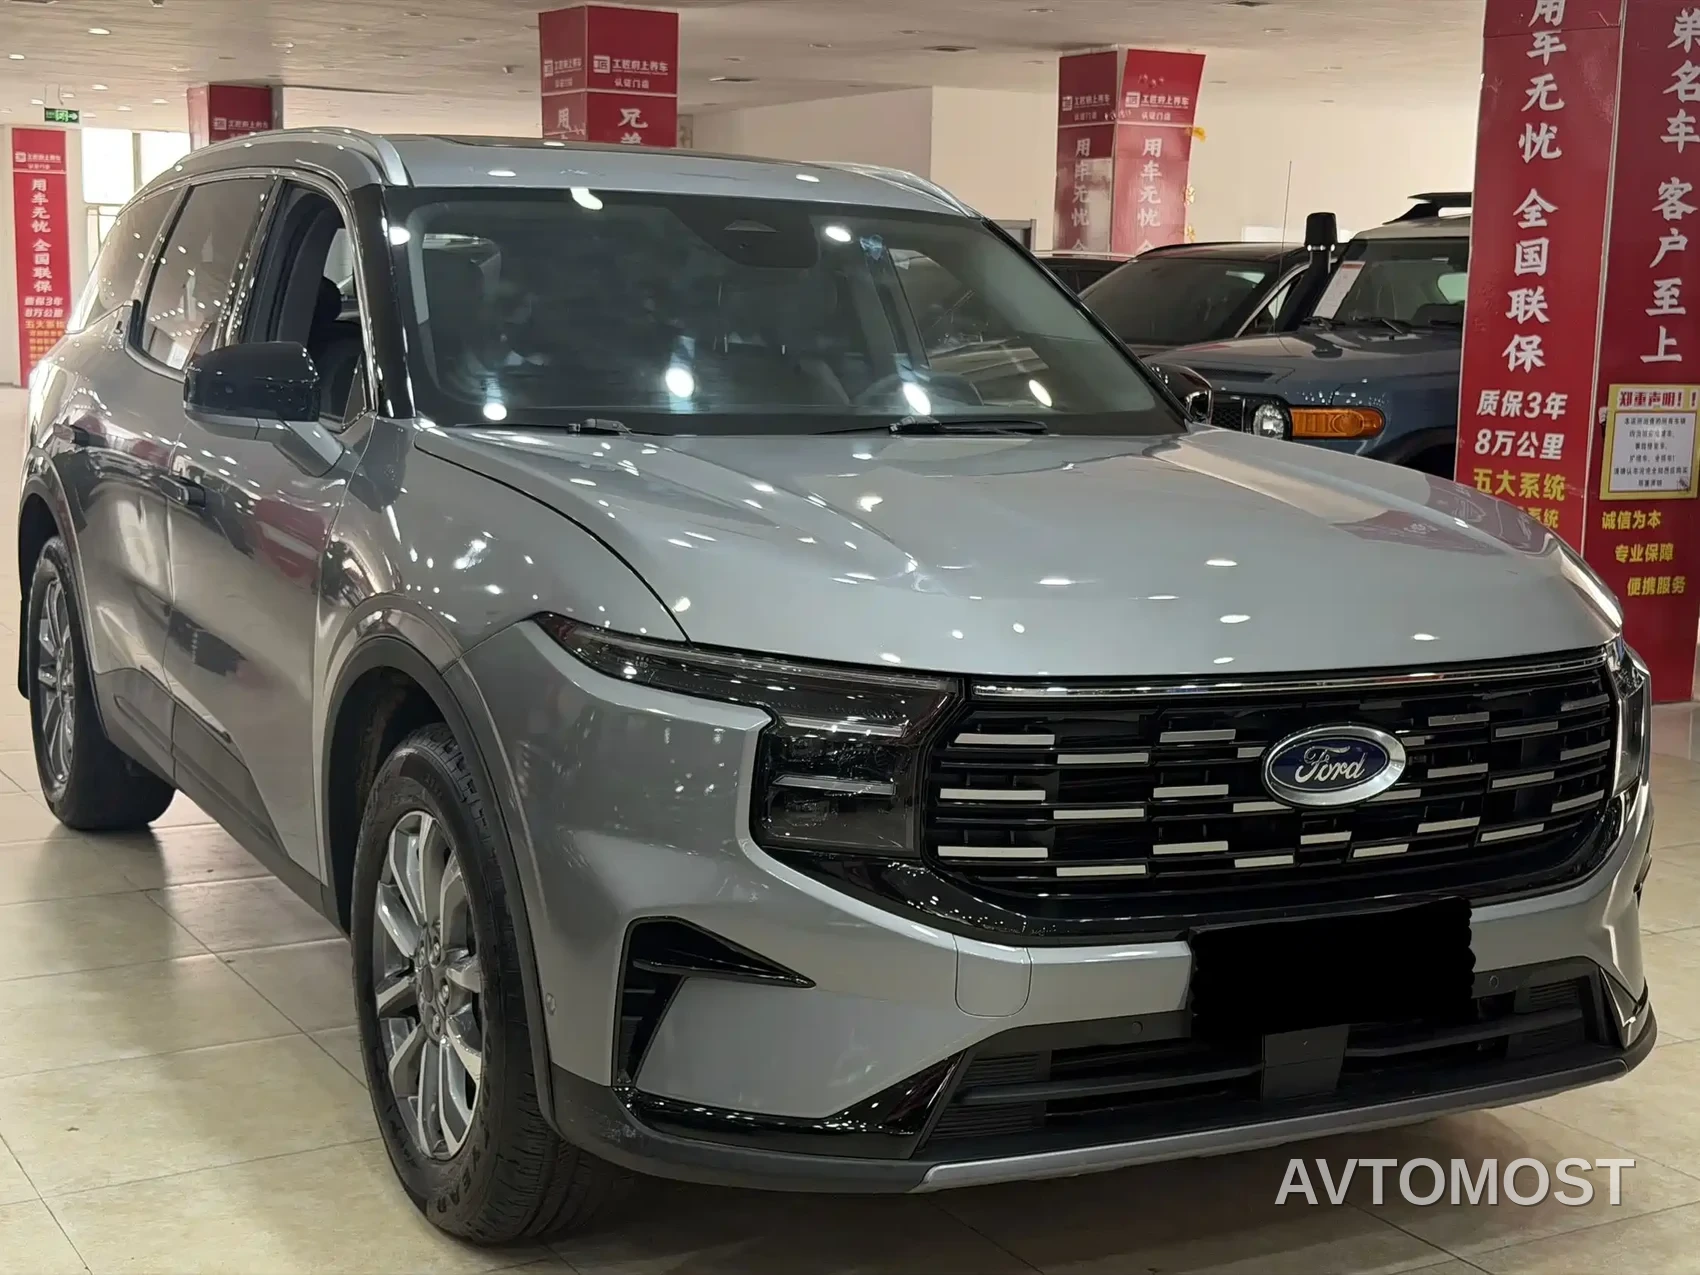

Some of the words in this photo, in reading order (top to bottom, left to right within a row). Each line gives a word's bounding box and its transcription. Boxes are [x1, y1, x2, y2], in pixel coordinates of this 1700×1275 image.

[1518, 0, 1567, 163] 用车无忧
[1660, 8, 1700, 153] 弟名车
[1502, 188, 1559, 373] 全国联保
[1640, 176, 1698, 364] 客户至上
[1476, 389, 1568, 420] 质保3年
[1474, 428, 1565, 460] 8万公里
[1473, 468, 1566, 501] 五大系统
[1602, 509, 1661, 530] 诚信为本
[1615, 543, 1674, 563] 专业保障
[1627, 576, 1686, 596] 便携服务
[1294, 746, 1368, 783] Ford
